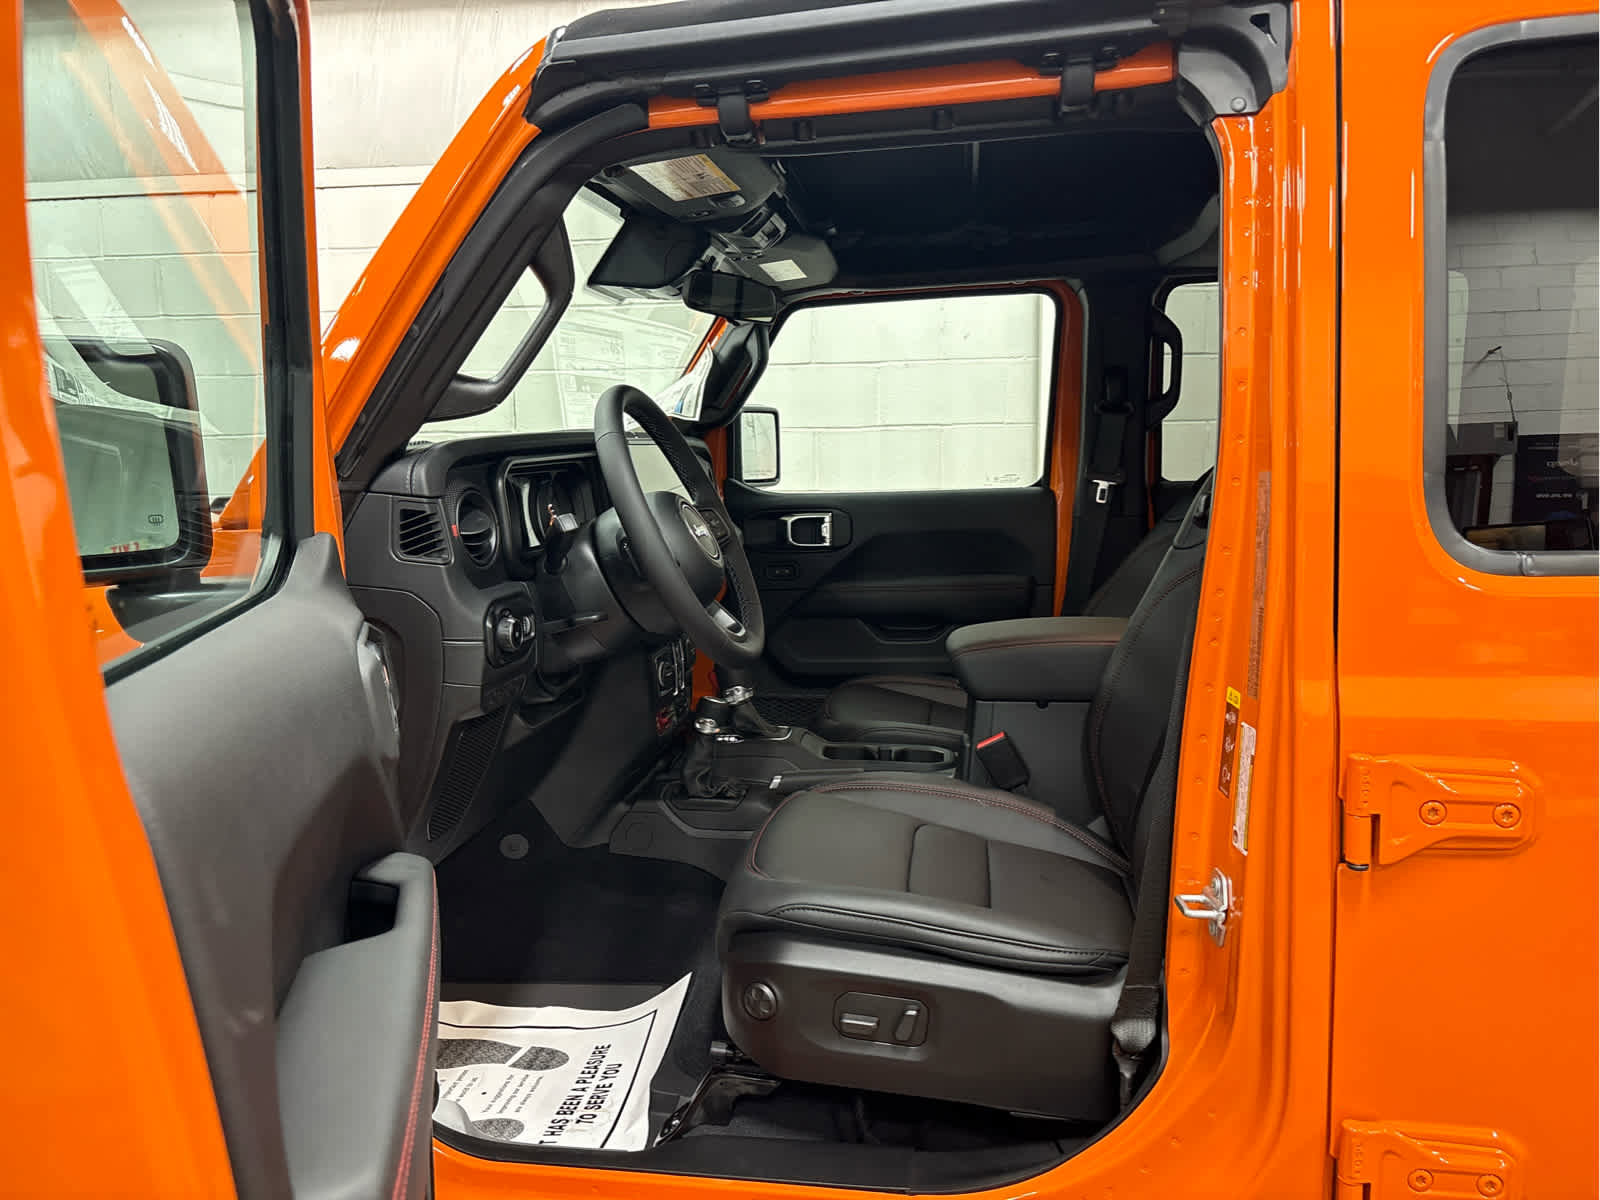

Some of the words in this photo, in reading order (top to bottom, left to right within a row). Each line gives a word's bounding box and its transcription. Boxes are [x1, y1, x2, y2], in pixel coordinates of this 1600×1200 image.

[575, 1043, 612, 1084] PLEASURE
[598, 1063, 623, 1082] YOU
[555, 1094, 585, 1116] BEEN
[584, 1082, 614, 1111] SERVE
[543, 1118, 570, 1137] HAS
[575, 1113, 598, 1125] TO
